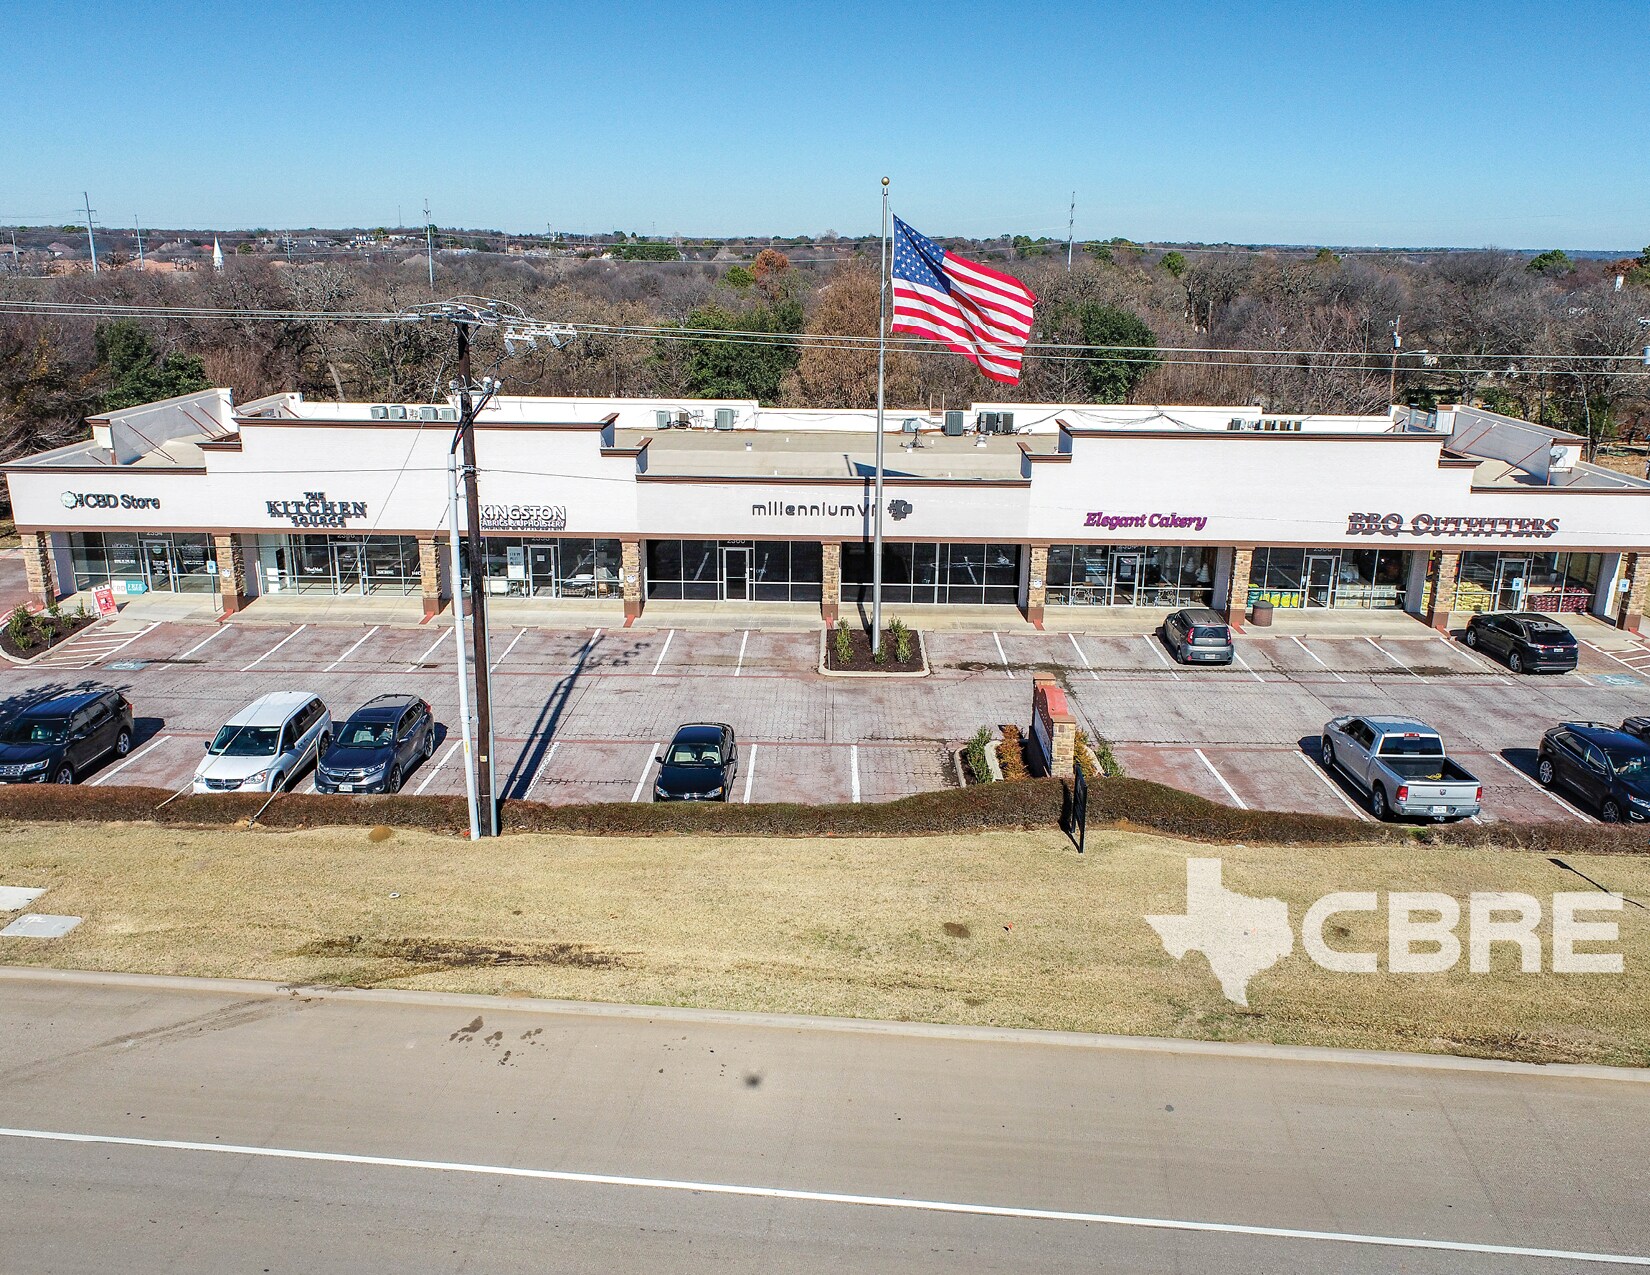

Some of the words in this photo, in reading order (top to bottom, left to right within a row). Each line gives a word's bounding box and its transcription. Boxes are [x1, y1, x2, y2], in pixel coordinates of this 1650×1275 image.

[84, 493, 119, 508] CBD
[120, 494, 160, 509] Store
[303, 492, 325, 501] THE
[265, 501, 367, 517] KITCHEN
[479, 505, 566, 521] KINGSTON
[291, 515, 346, 527] SOURCE
[480, 519, 509, 529] FABRICS
[518, 520, 566, 530] UPHOLSTERY
[1083, 512, 1147, 530] Elegant
[1148, 512, 1208, 531] Cakery
[1347, 512, 1404, 535] BBQ
[1410, 514, 1560, 535] OUTFITTERS
